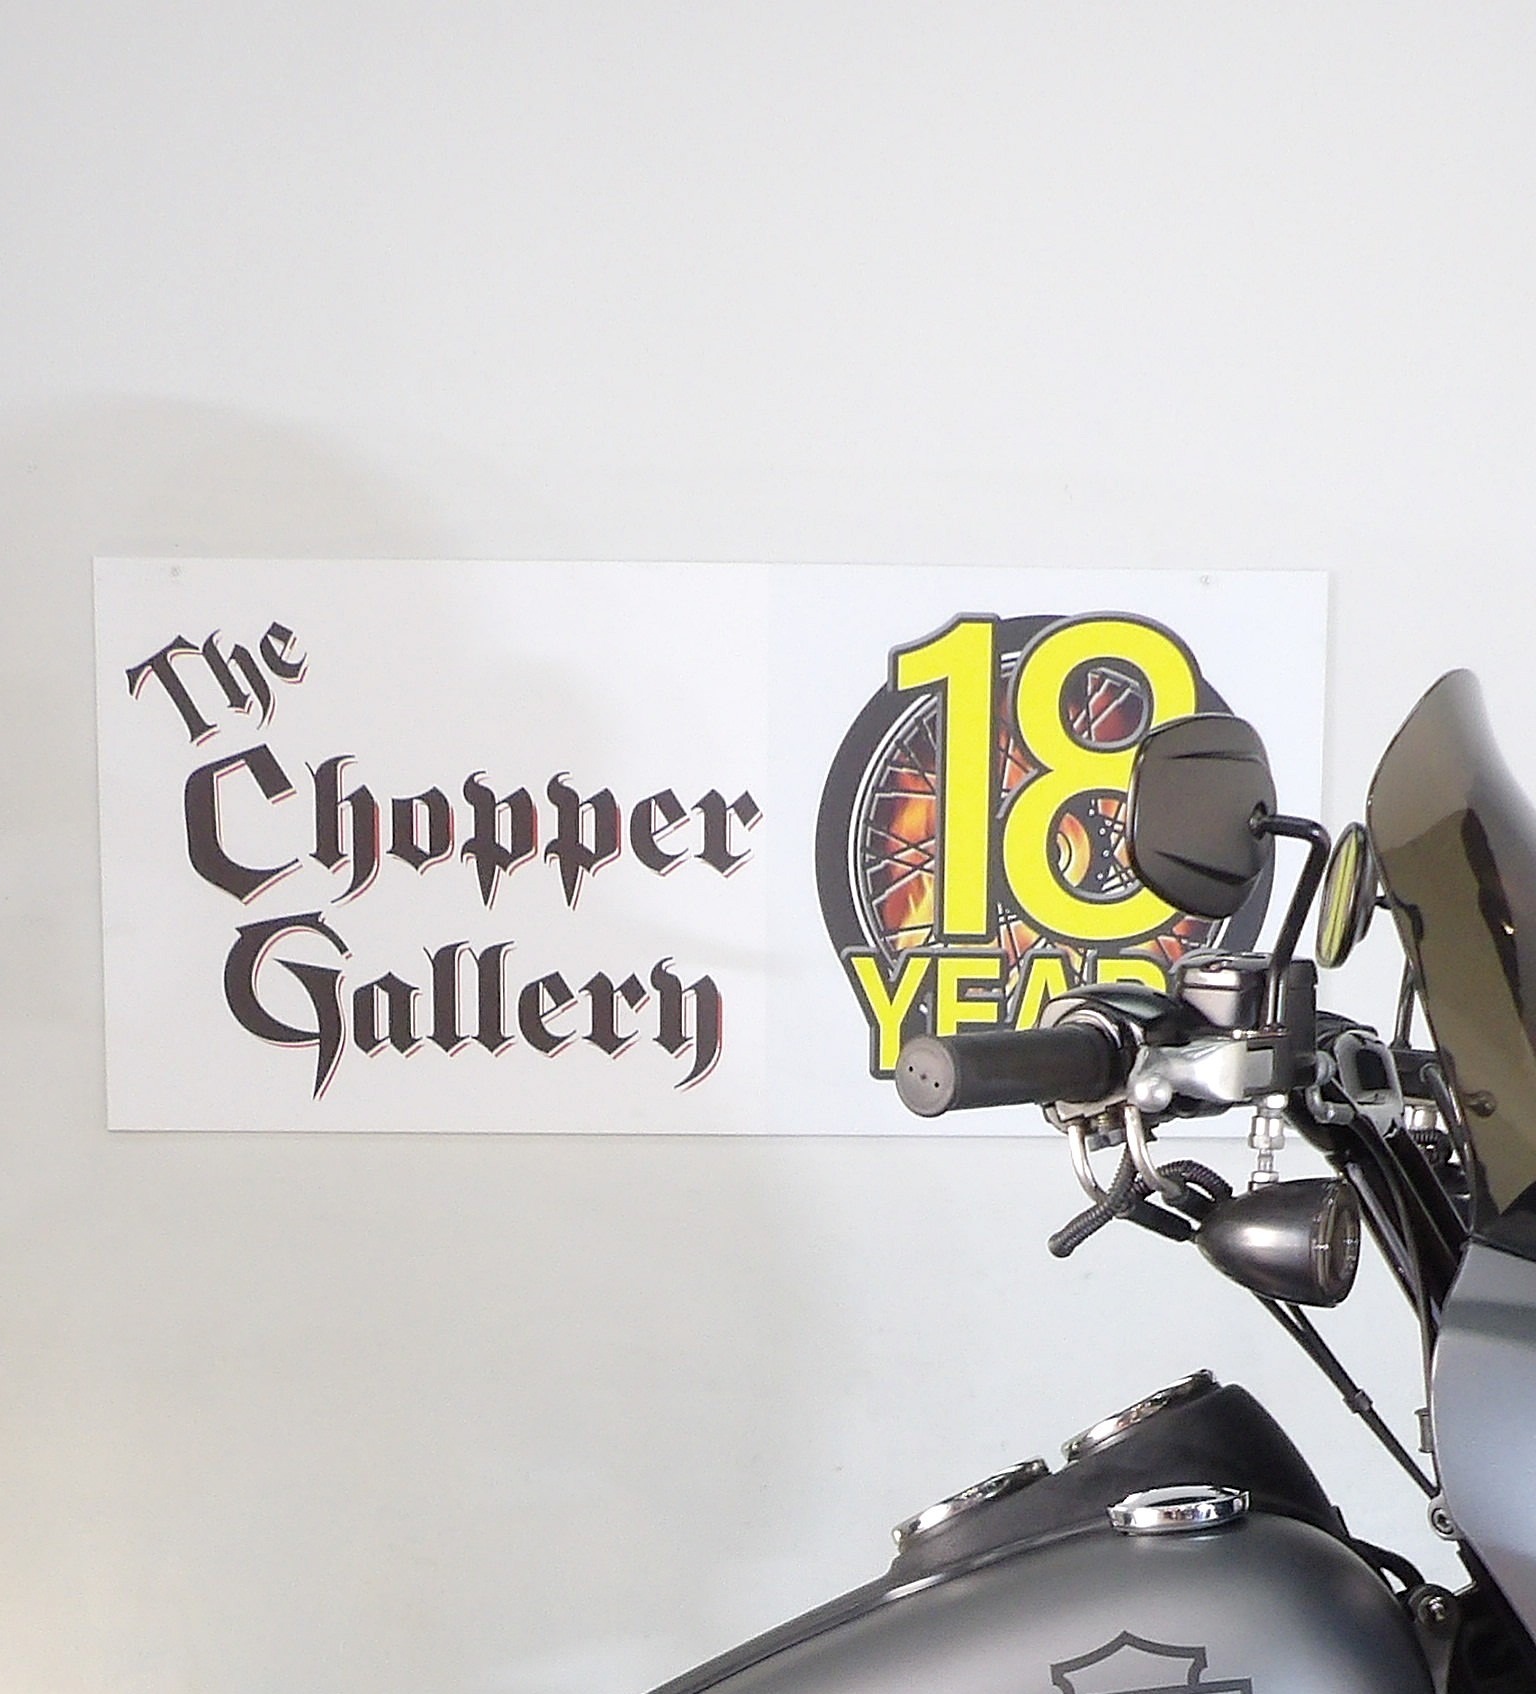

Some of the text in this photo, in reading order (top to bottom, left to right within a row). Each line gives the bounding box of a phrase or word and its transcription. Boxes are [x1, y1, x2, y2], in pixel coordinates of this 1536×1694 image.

[125, 621, 309, 746] The
[184, 742, 764, 911] Chopper
[890, 613, 1199, 944] 18
[223, 911, 724, 1102] Gallery
[848, 952, 1169, 1072] YEA
